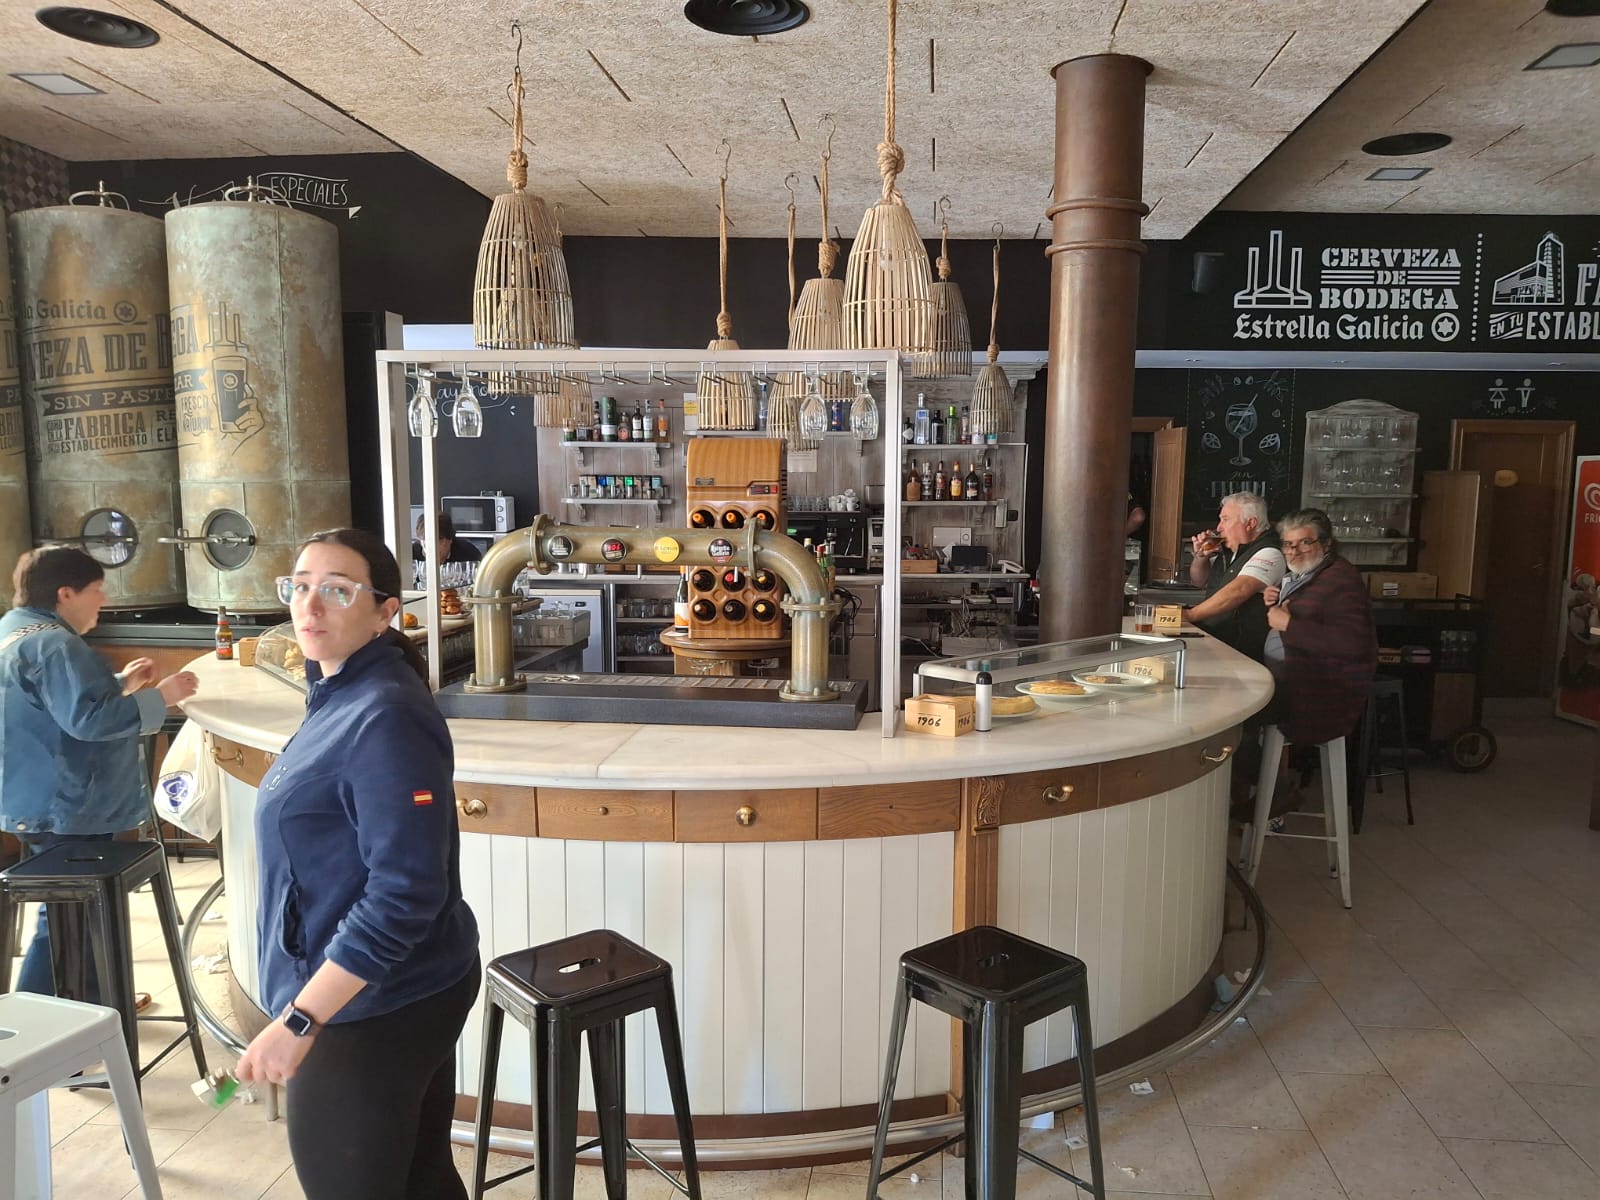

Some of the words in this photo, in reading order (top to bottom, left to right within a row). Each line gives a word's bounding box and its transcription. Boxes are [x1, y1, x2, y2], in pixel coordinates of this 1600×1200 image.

[270, 176, 348, 206] ESPECIALES
[1321, 248, 1461, 268] CERVEZA
[1376, 270, 1407, 285] DE
[37, 299, 106, 320] Galicia
[1319, 287, 1459, 310] BODEGA
[1233, 313, 1330, 340] Estrella
[1336, 313, 1424, 341] Galicia
[1489, 321, 1505, 338] EN
[1510, 313, 1524, 329] TU
[104, 332, 147, 372] DE
[54, 393, 92, 411] SIN
[64, 411, 145, 440] FABRICA
[61, 433, 147, 454] ESTABLECIMIENTO
[918, 716, 942, 727] 1906
